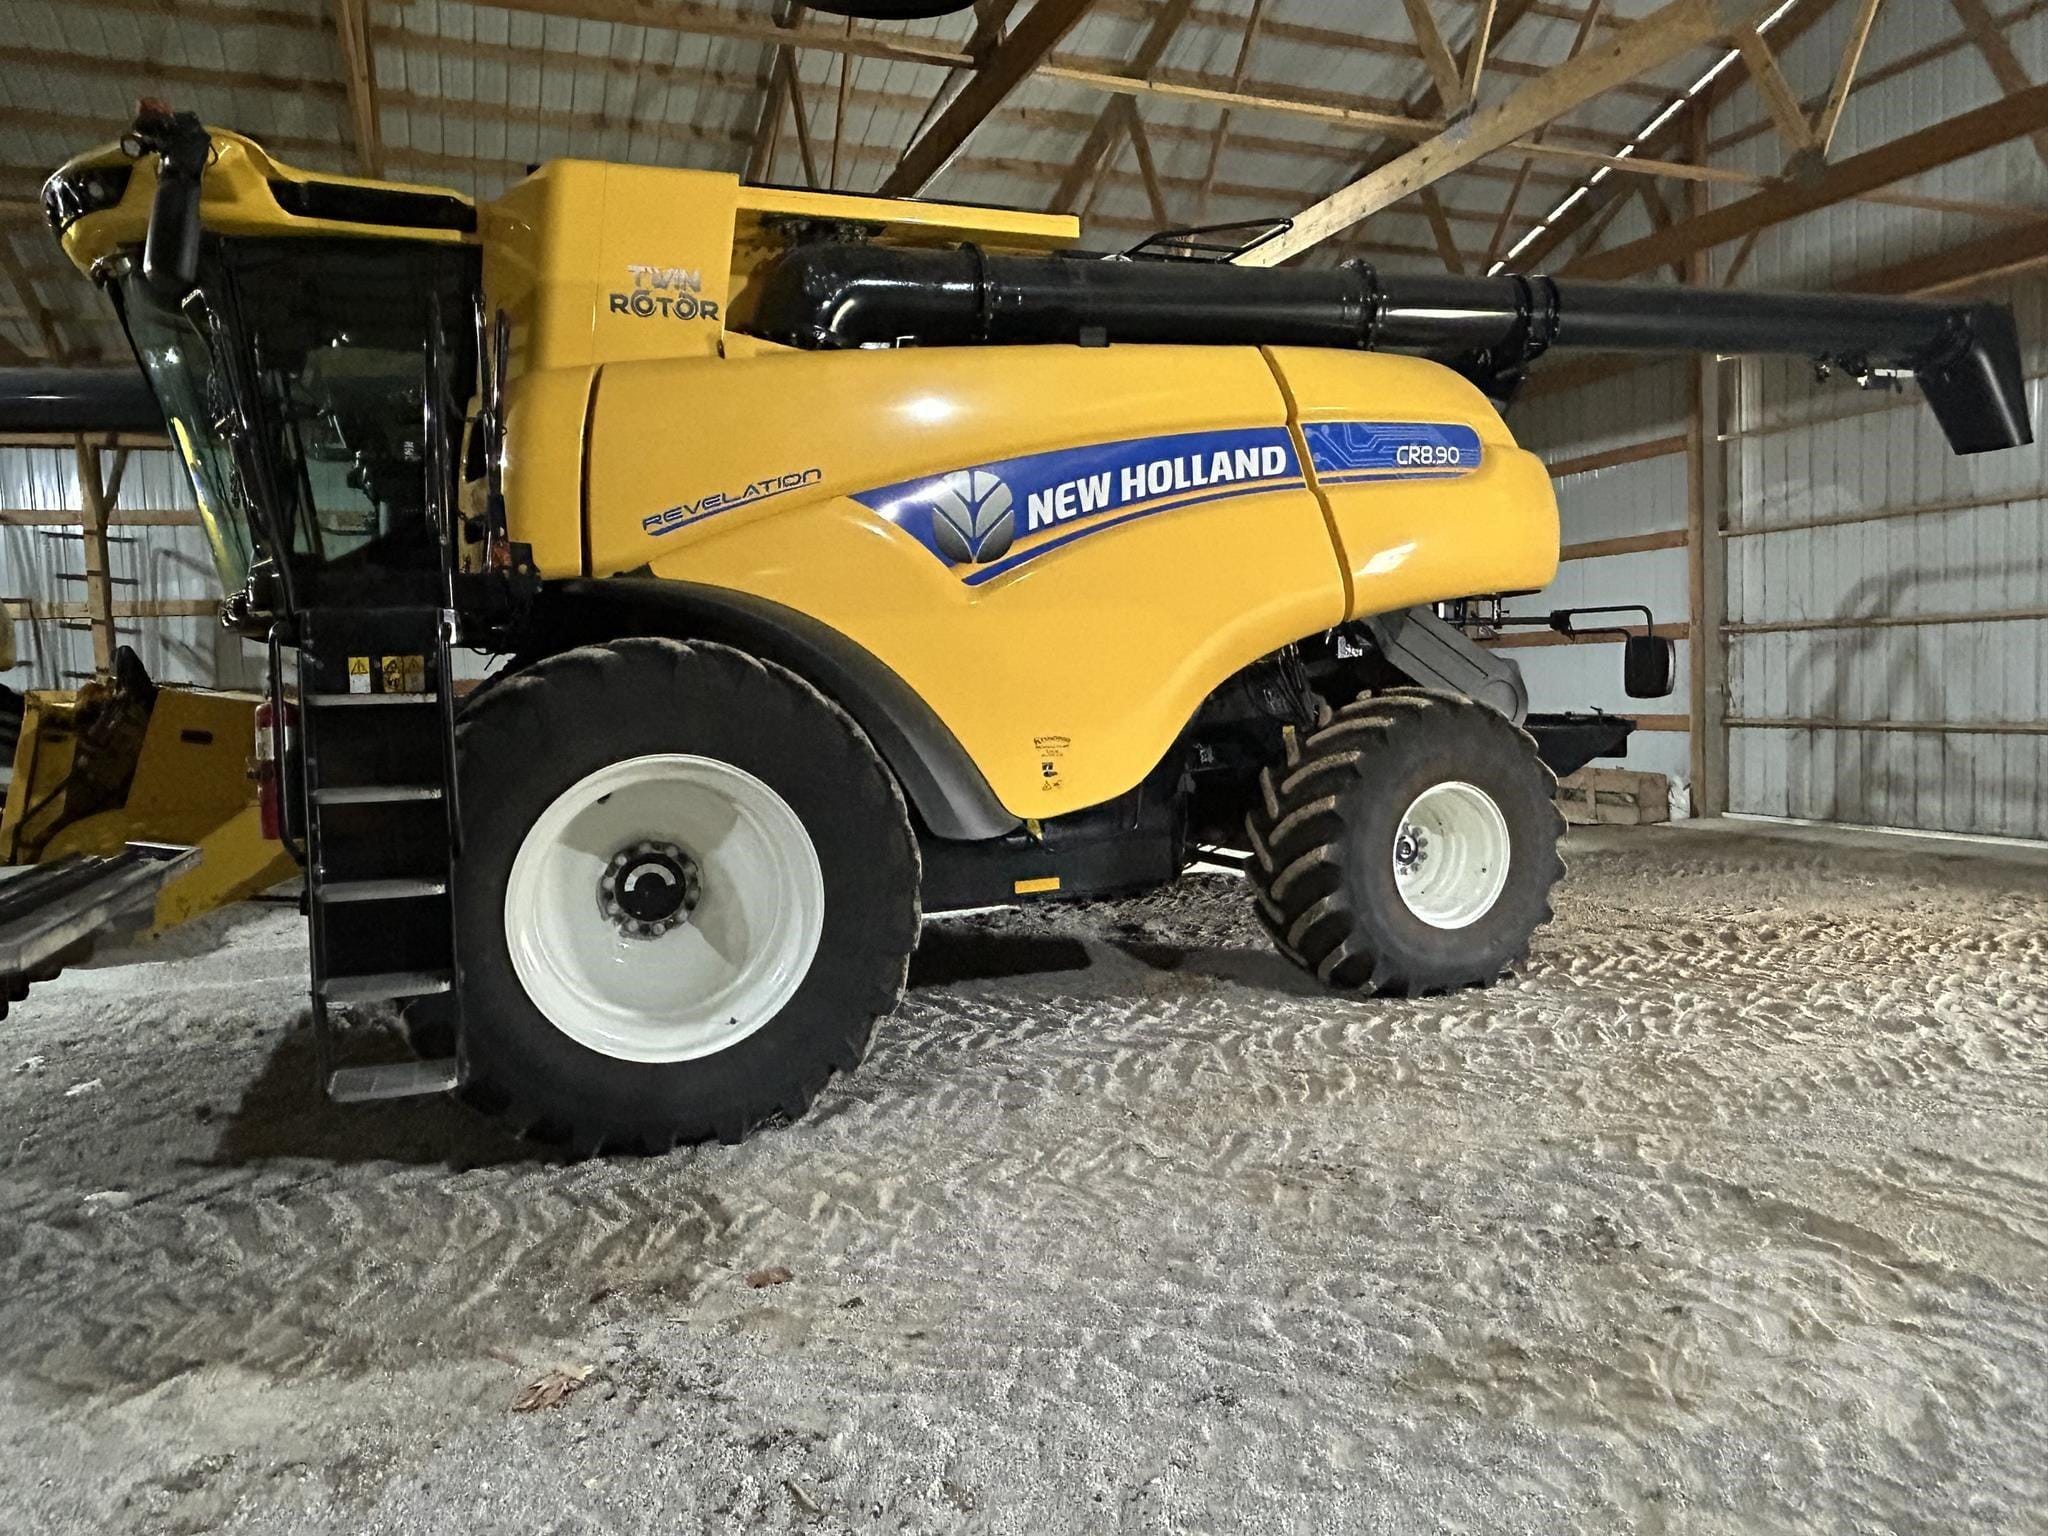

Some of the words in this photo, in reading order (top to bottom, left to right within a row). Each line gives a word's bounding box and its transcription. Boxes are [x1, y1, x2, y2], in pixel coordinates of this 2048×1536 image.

[627, 265, 701, 292] TWIN
[609, 290, 720, 321] ROTOR
[1396, 445, 1460, 465] CR8.90
[642, 468, 822, 531] REVELATION
[1027, 471, 1111, 531] NEW
[1120, 445, 1287, 502] HOLLAND
